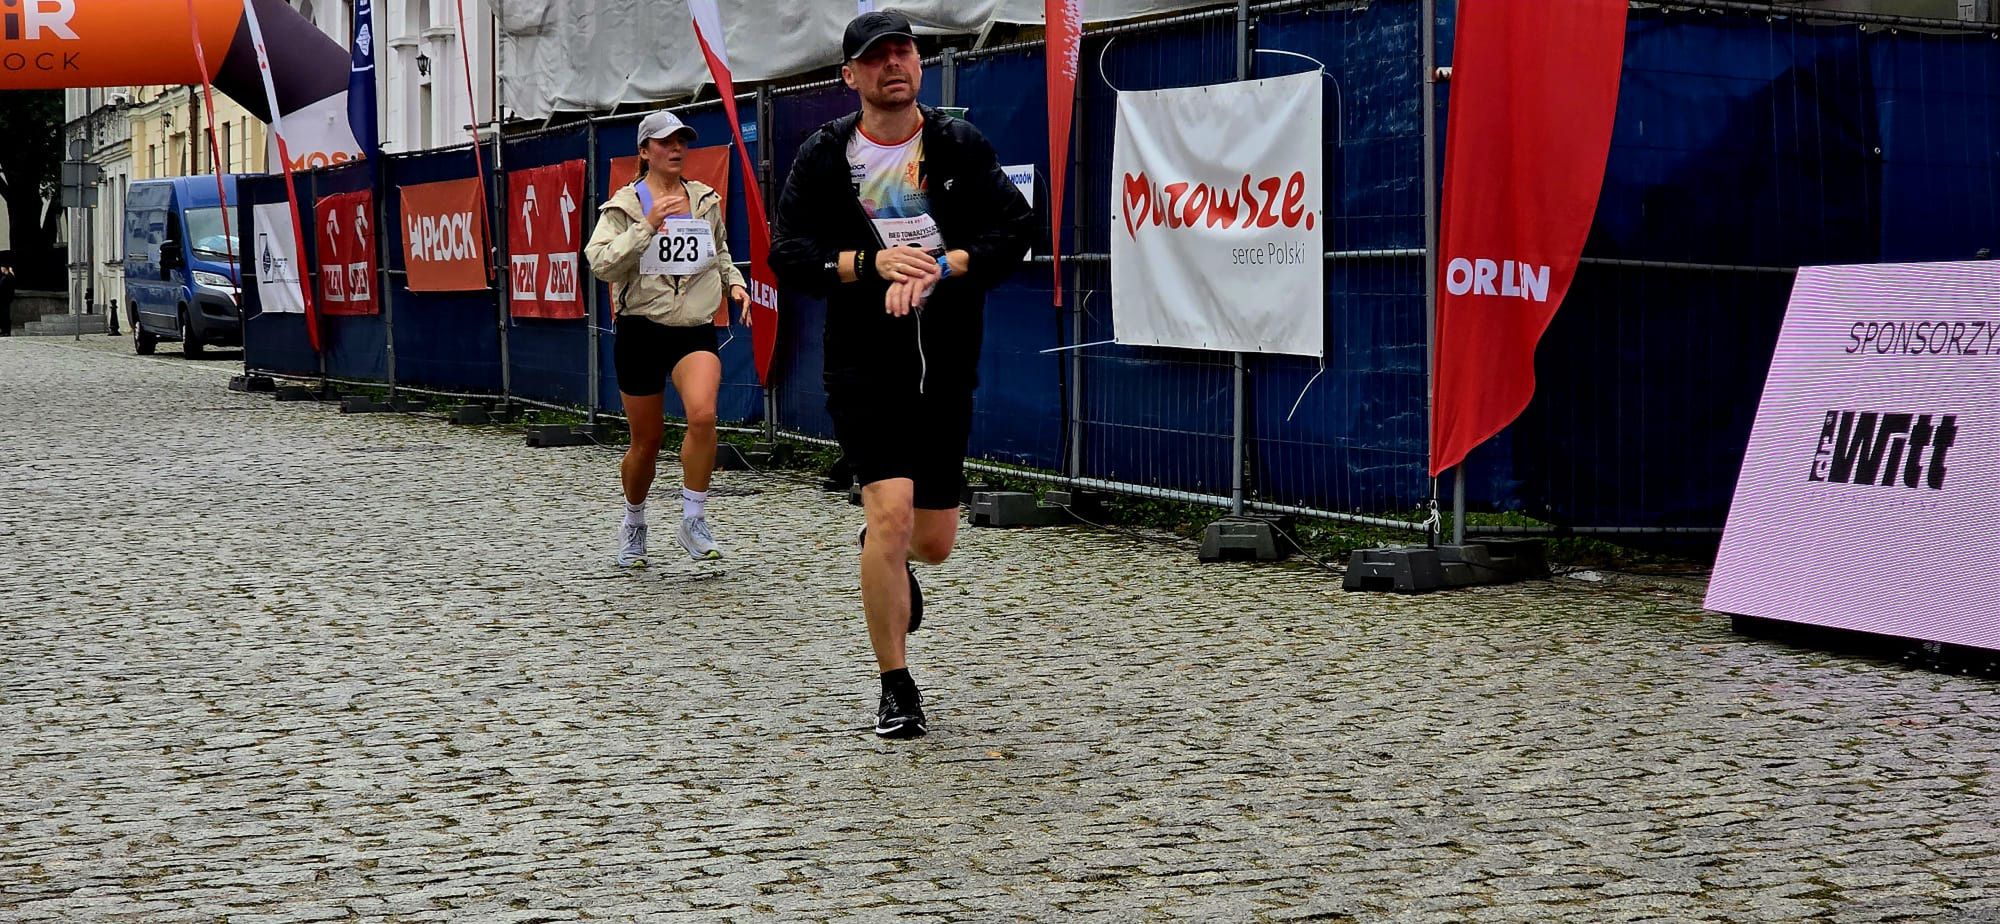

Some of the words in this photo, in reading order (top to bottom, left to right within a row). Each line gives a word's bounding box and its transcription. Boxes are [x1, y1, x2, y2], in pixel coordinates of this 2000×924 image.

[3, 52, 80, 71] OCK
[422, 212, 477, 261] PŁOCK
[658, 236, 699, 263] 823
[1232, 249, 1264, 265] serce
[1268, 242, 1305, 265] Polski
[1446, 257, 1550, 302] ORLN
[751, 278, 778, 312] LEN
